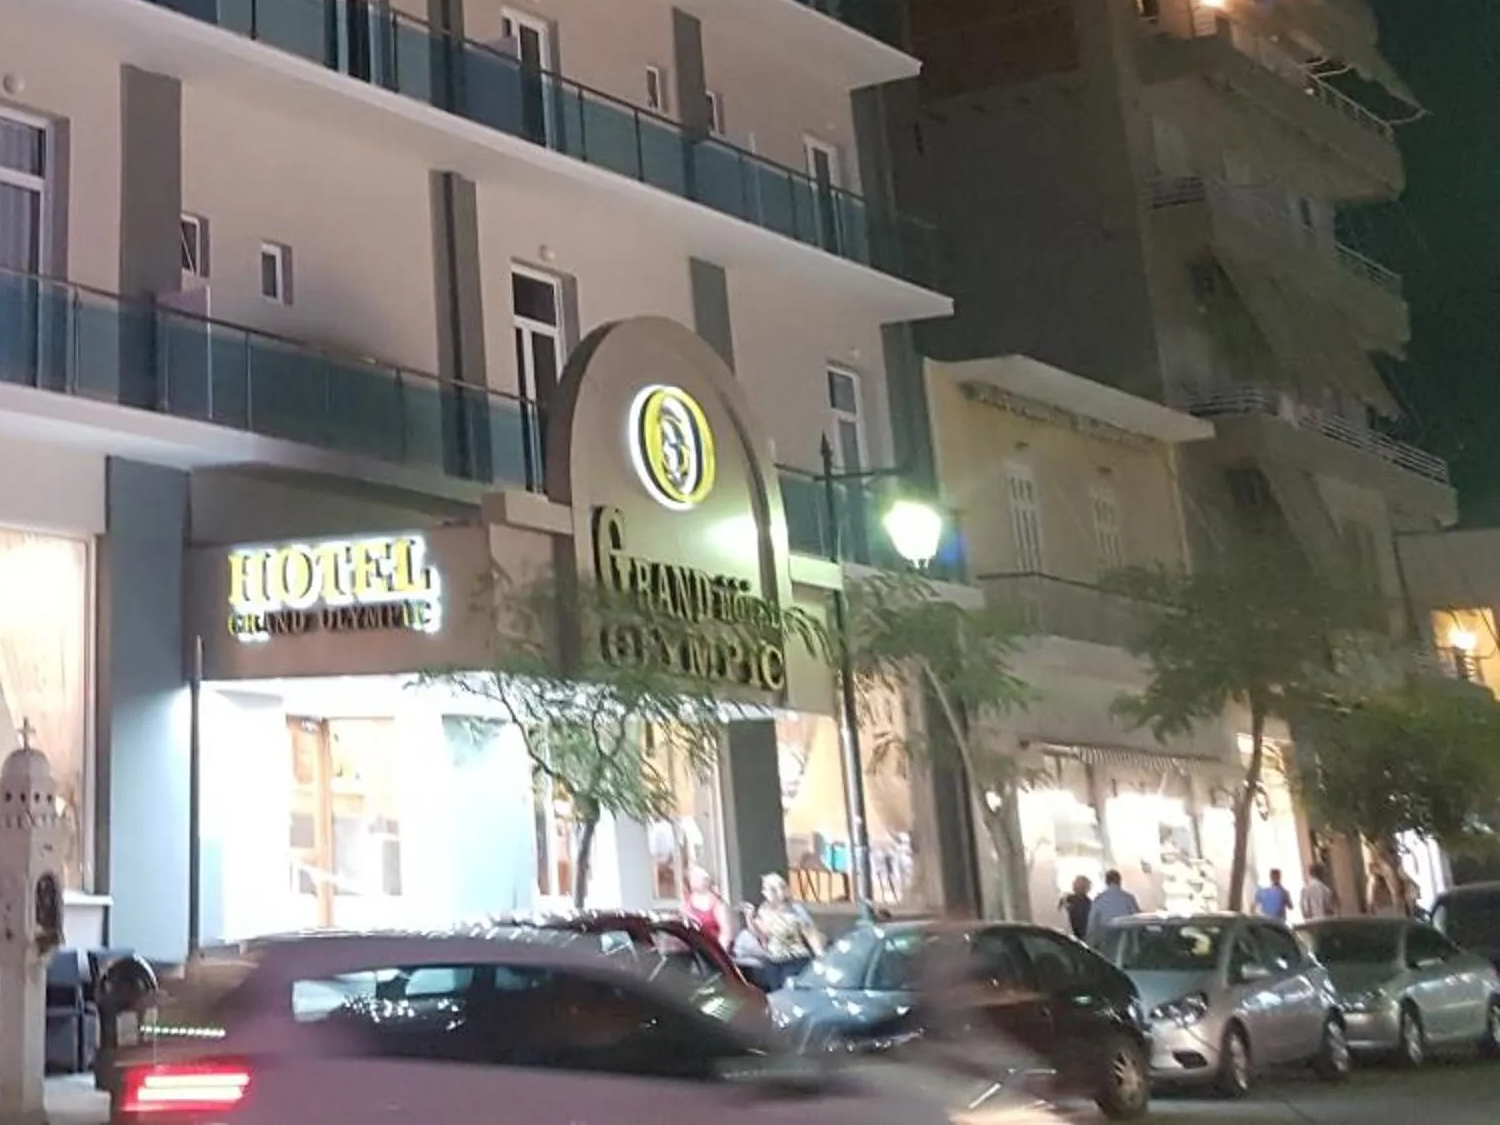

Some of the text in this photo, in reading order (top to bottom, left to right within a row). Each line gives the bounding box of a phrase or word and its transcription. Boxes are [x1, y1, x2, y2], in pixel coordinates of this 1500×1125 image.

[228, 538, 434, 607] HOTEL
[592, 505, 712, 622] GRAND
[228, 599, 436, 636] GRAND OLYMPIC
